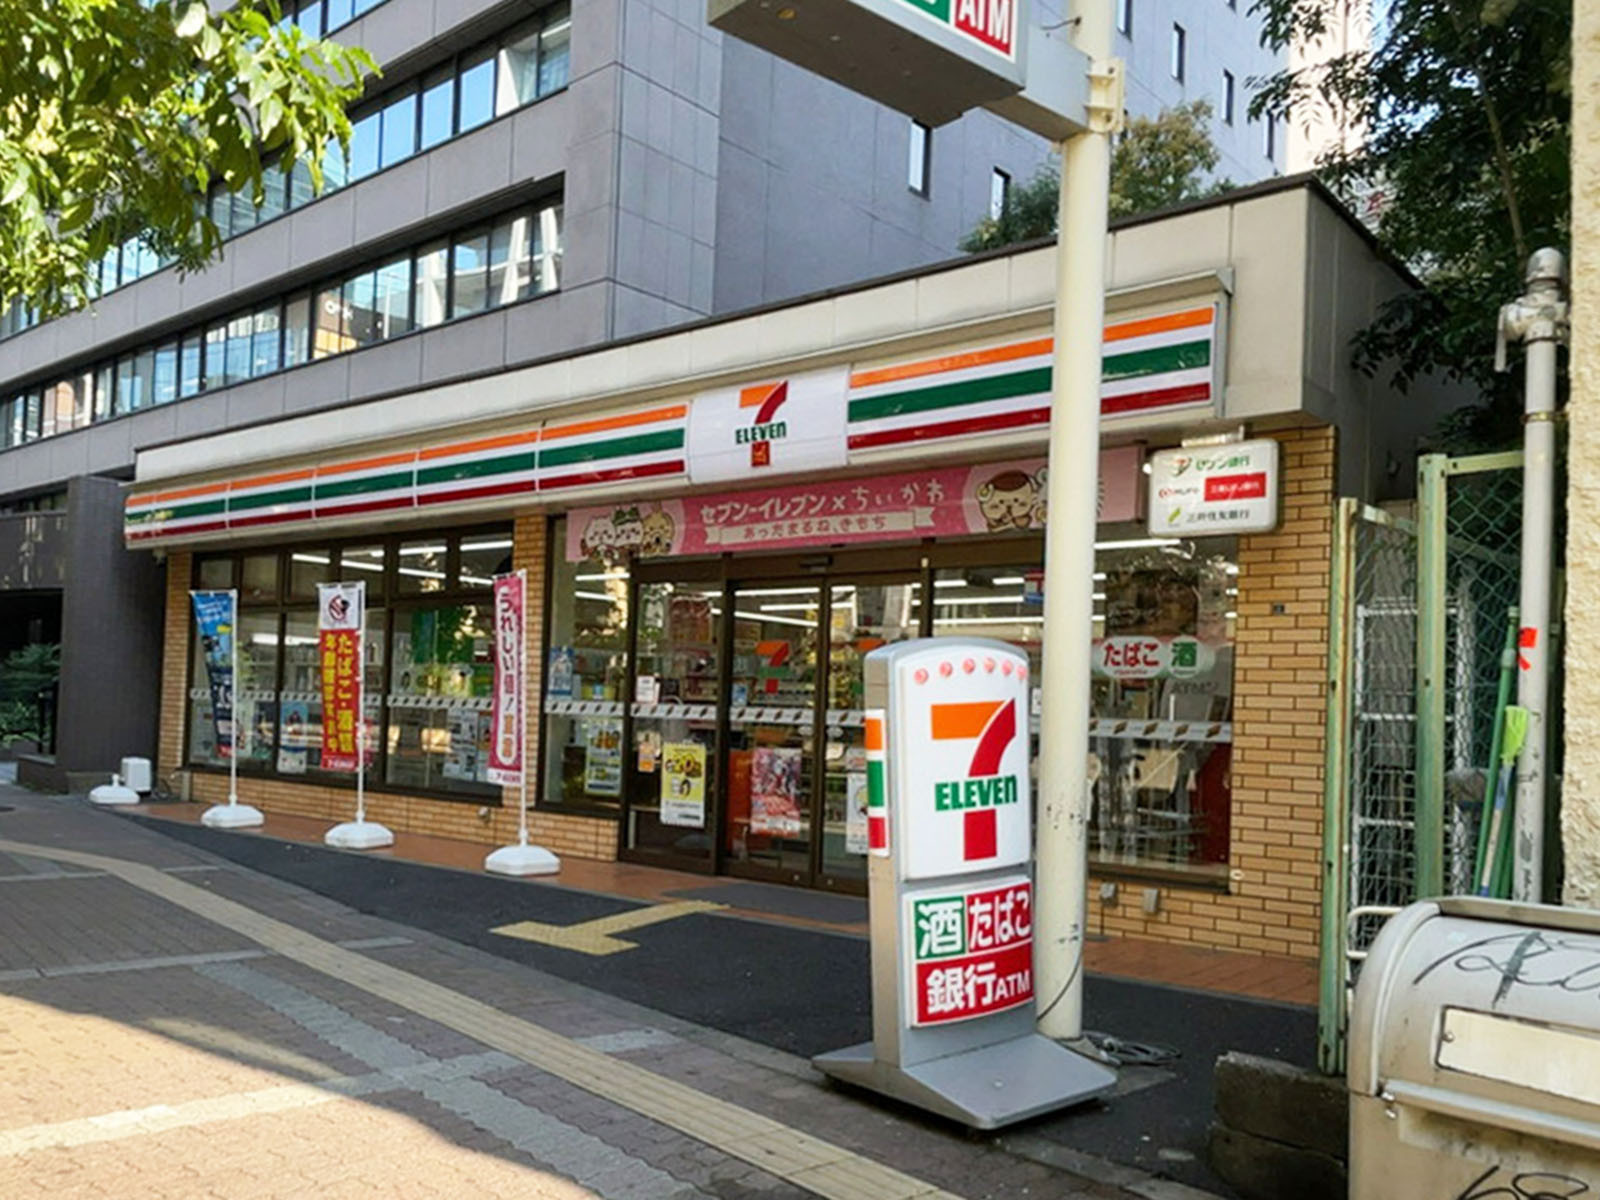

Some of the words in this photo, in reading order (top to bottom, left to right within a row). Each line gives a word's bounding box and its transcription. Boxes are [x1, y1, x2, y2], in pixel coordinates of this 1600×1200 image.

[1104, 641, 1160, 667] たばこ
[1171, 641, 1198, 667] 酒
[931, 697, 1017, 861] 7
[918, 901, 963, 957] 酒
[969, 890, 1031, 950] たばこ
[926, 961, 1031, 1014] 銀行ATM
